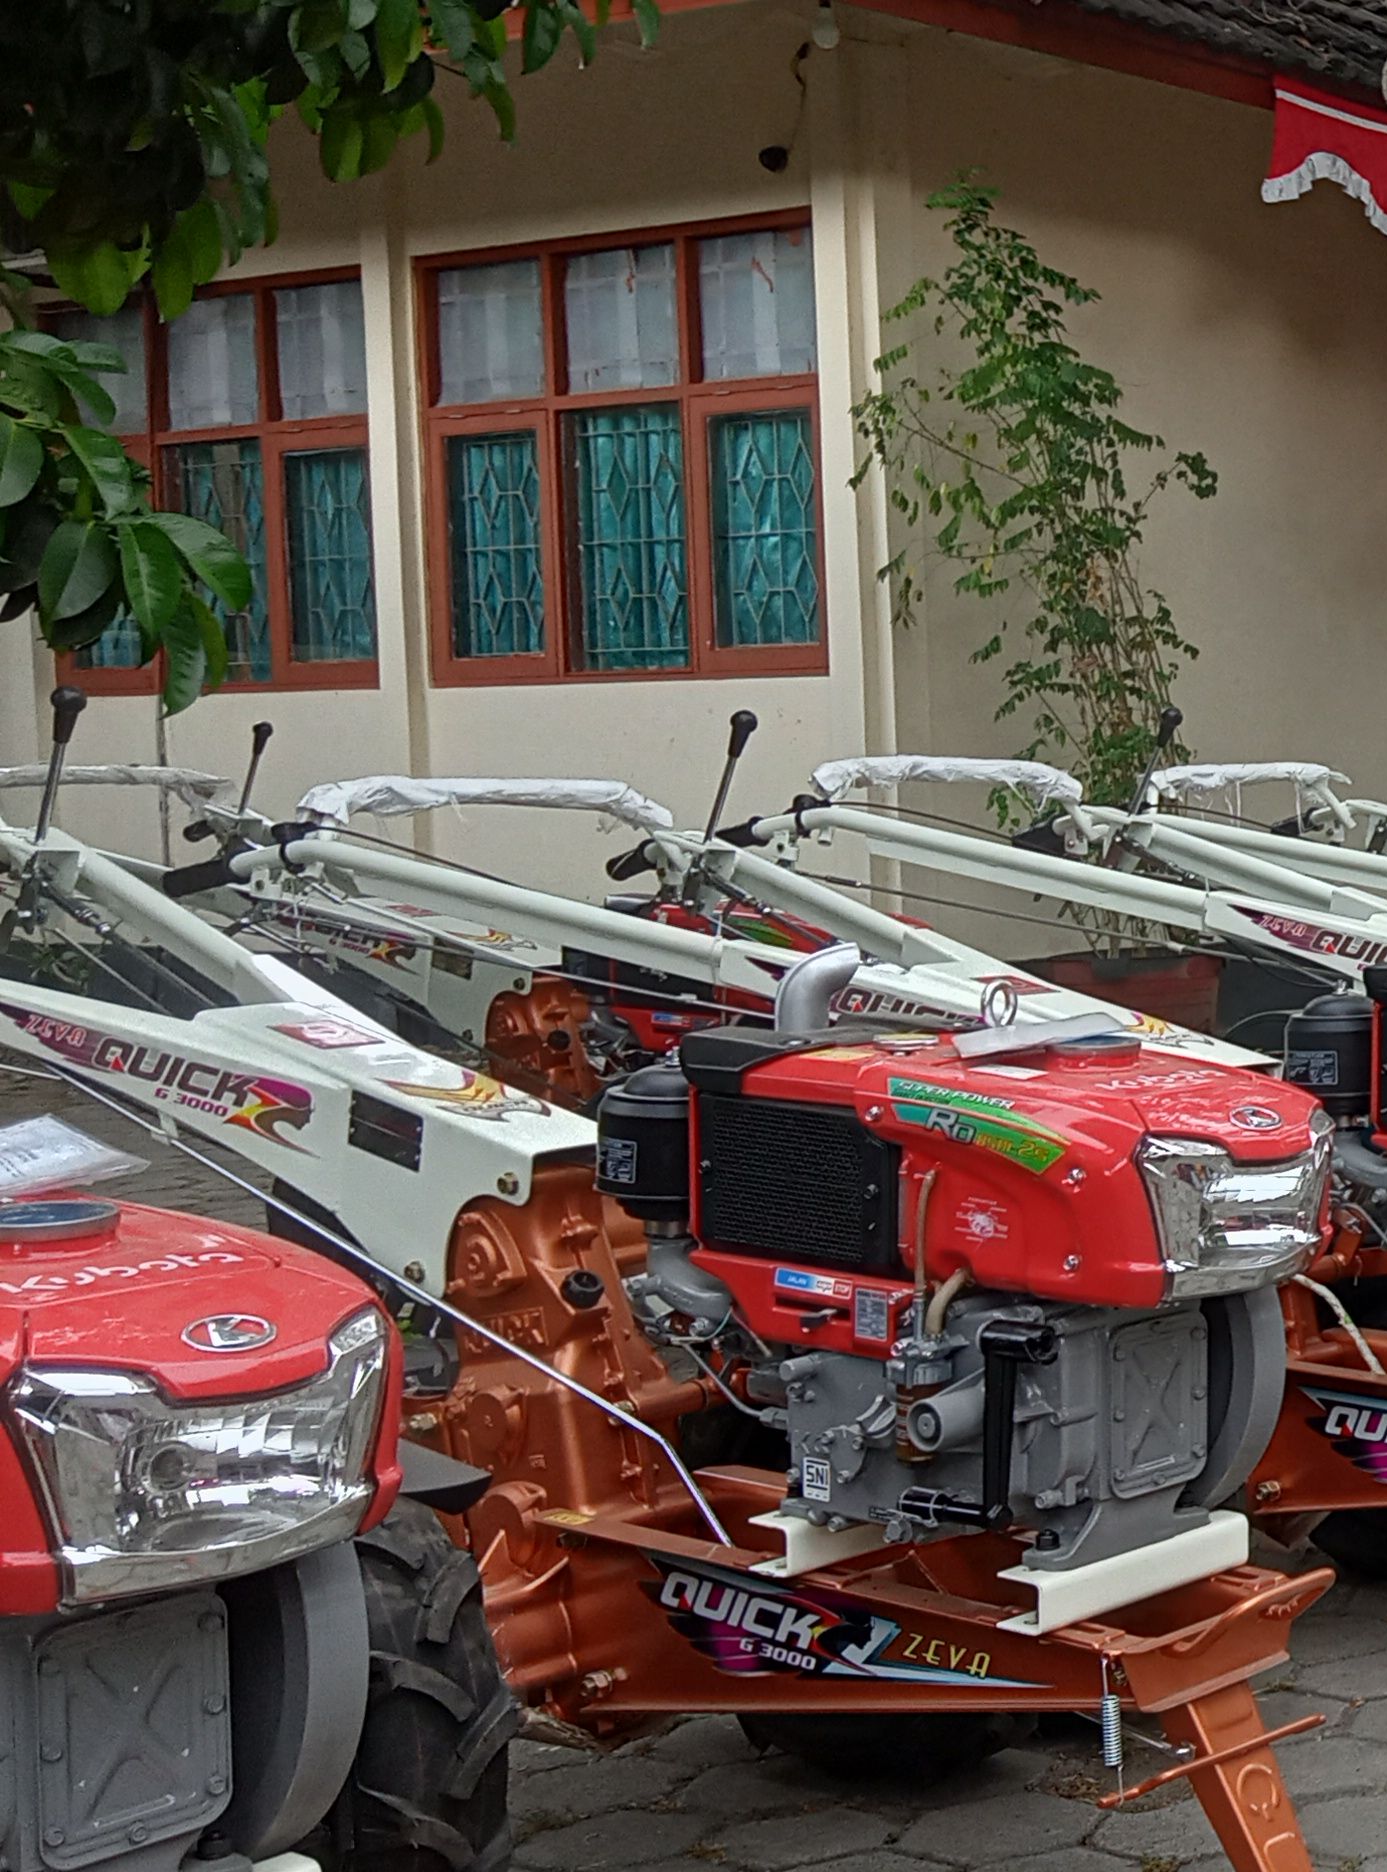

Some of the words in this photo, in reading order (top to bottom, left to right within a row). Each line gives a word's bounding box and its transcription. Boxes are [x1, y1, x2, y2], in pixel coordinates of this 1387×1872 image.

[24, 1014, 87, 1047] ZEVA
[94, 1036, 257, 1107] QUICK
[154, 1087, 169, 1100] G
[173, 1092, 229, 1117] 3000
[950, 1089, 1016, 1110] POWER
[0, 1252, 244, 1294] Kubota
[806, 1464, 829, 1486] SNI
[660, 1571, 822, 1649] QUICK
[902, 1633, 992, 1678] ZEVA
[739, 1637, 754, 1652] G
[758, 1642, 817, 1671] 3000
